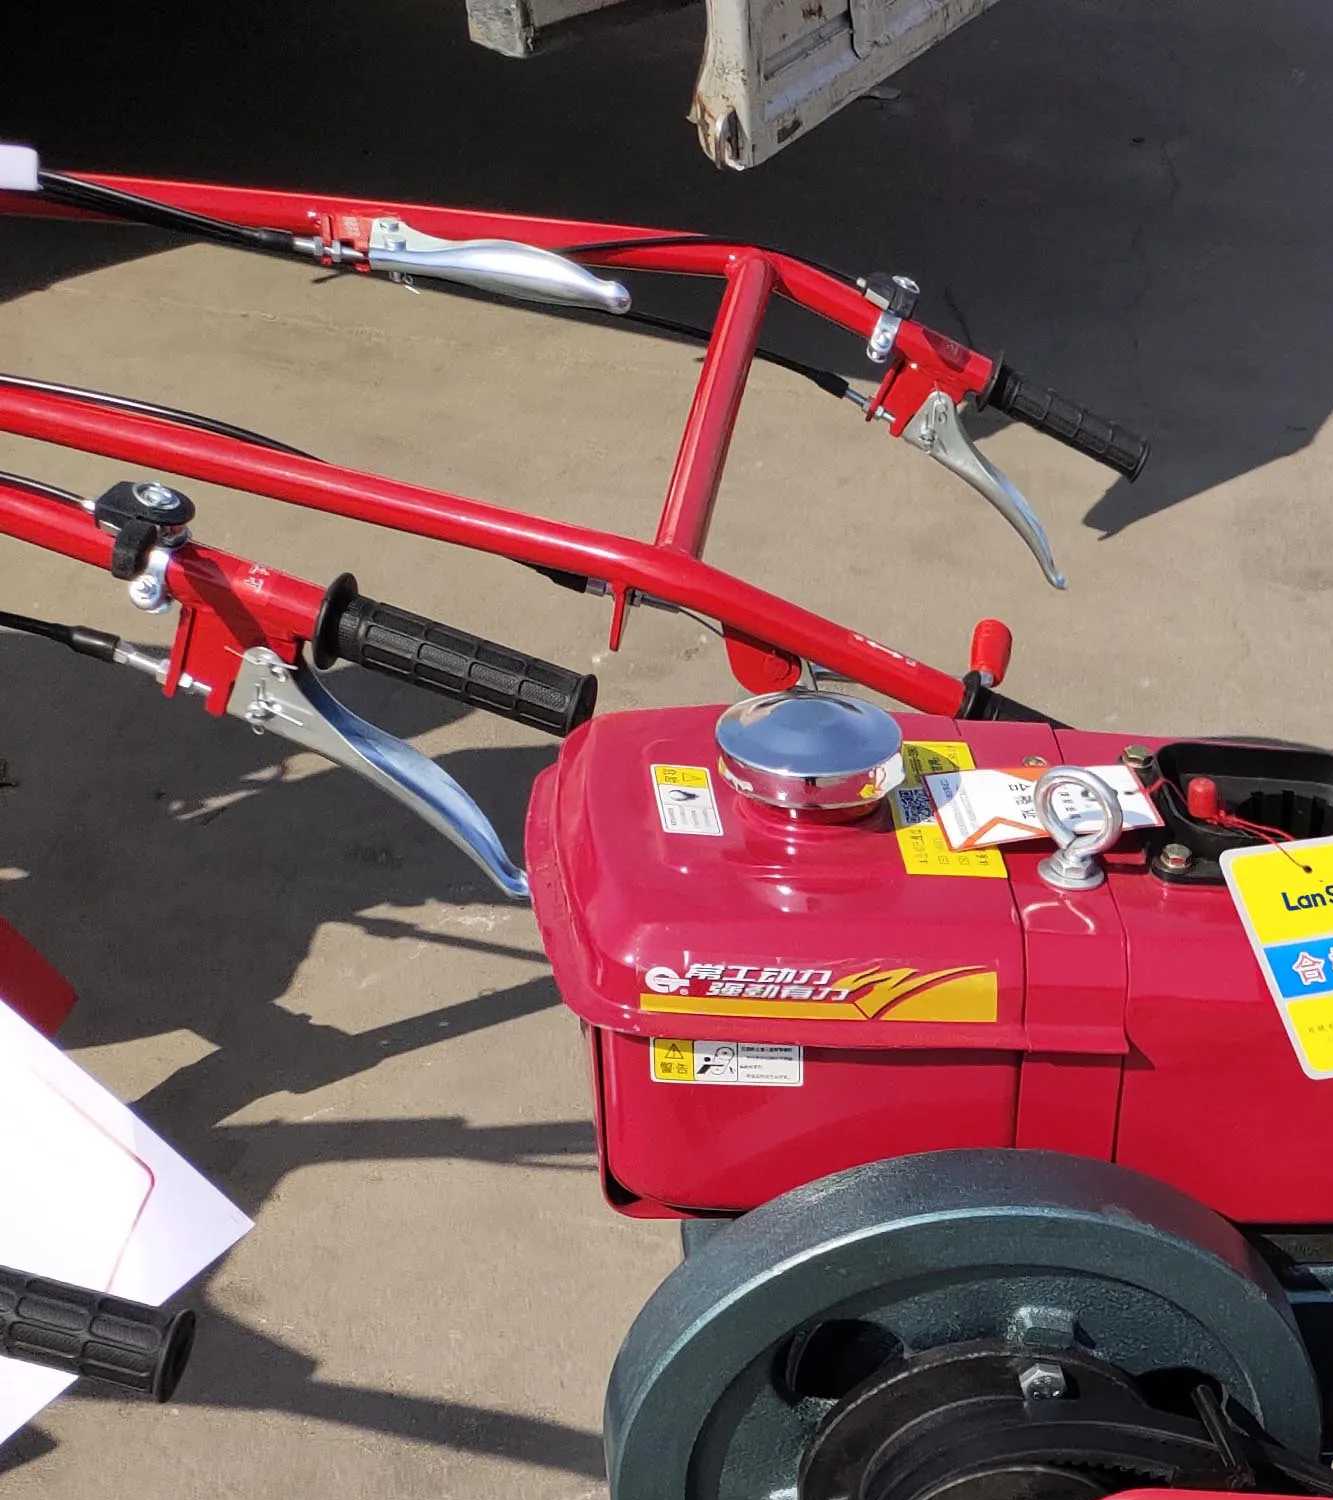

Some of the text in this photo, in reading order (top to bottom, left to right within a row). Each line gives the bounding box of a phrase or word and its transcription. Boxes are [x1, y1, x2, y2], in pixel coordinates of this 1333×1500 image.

[685, 963, 832, 985] 常工动力
[706, 981, 850, 1001] 强劲有力
